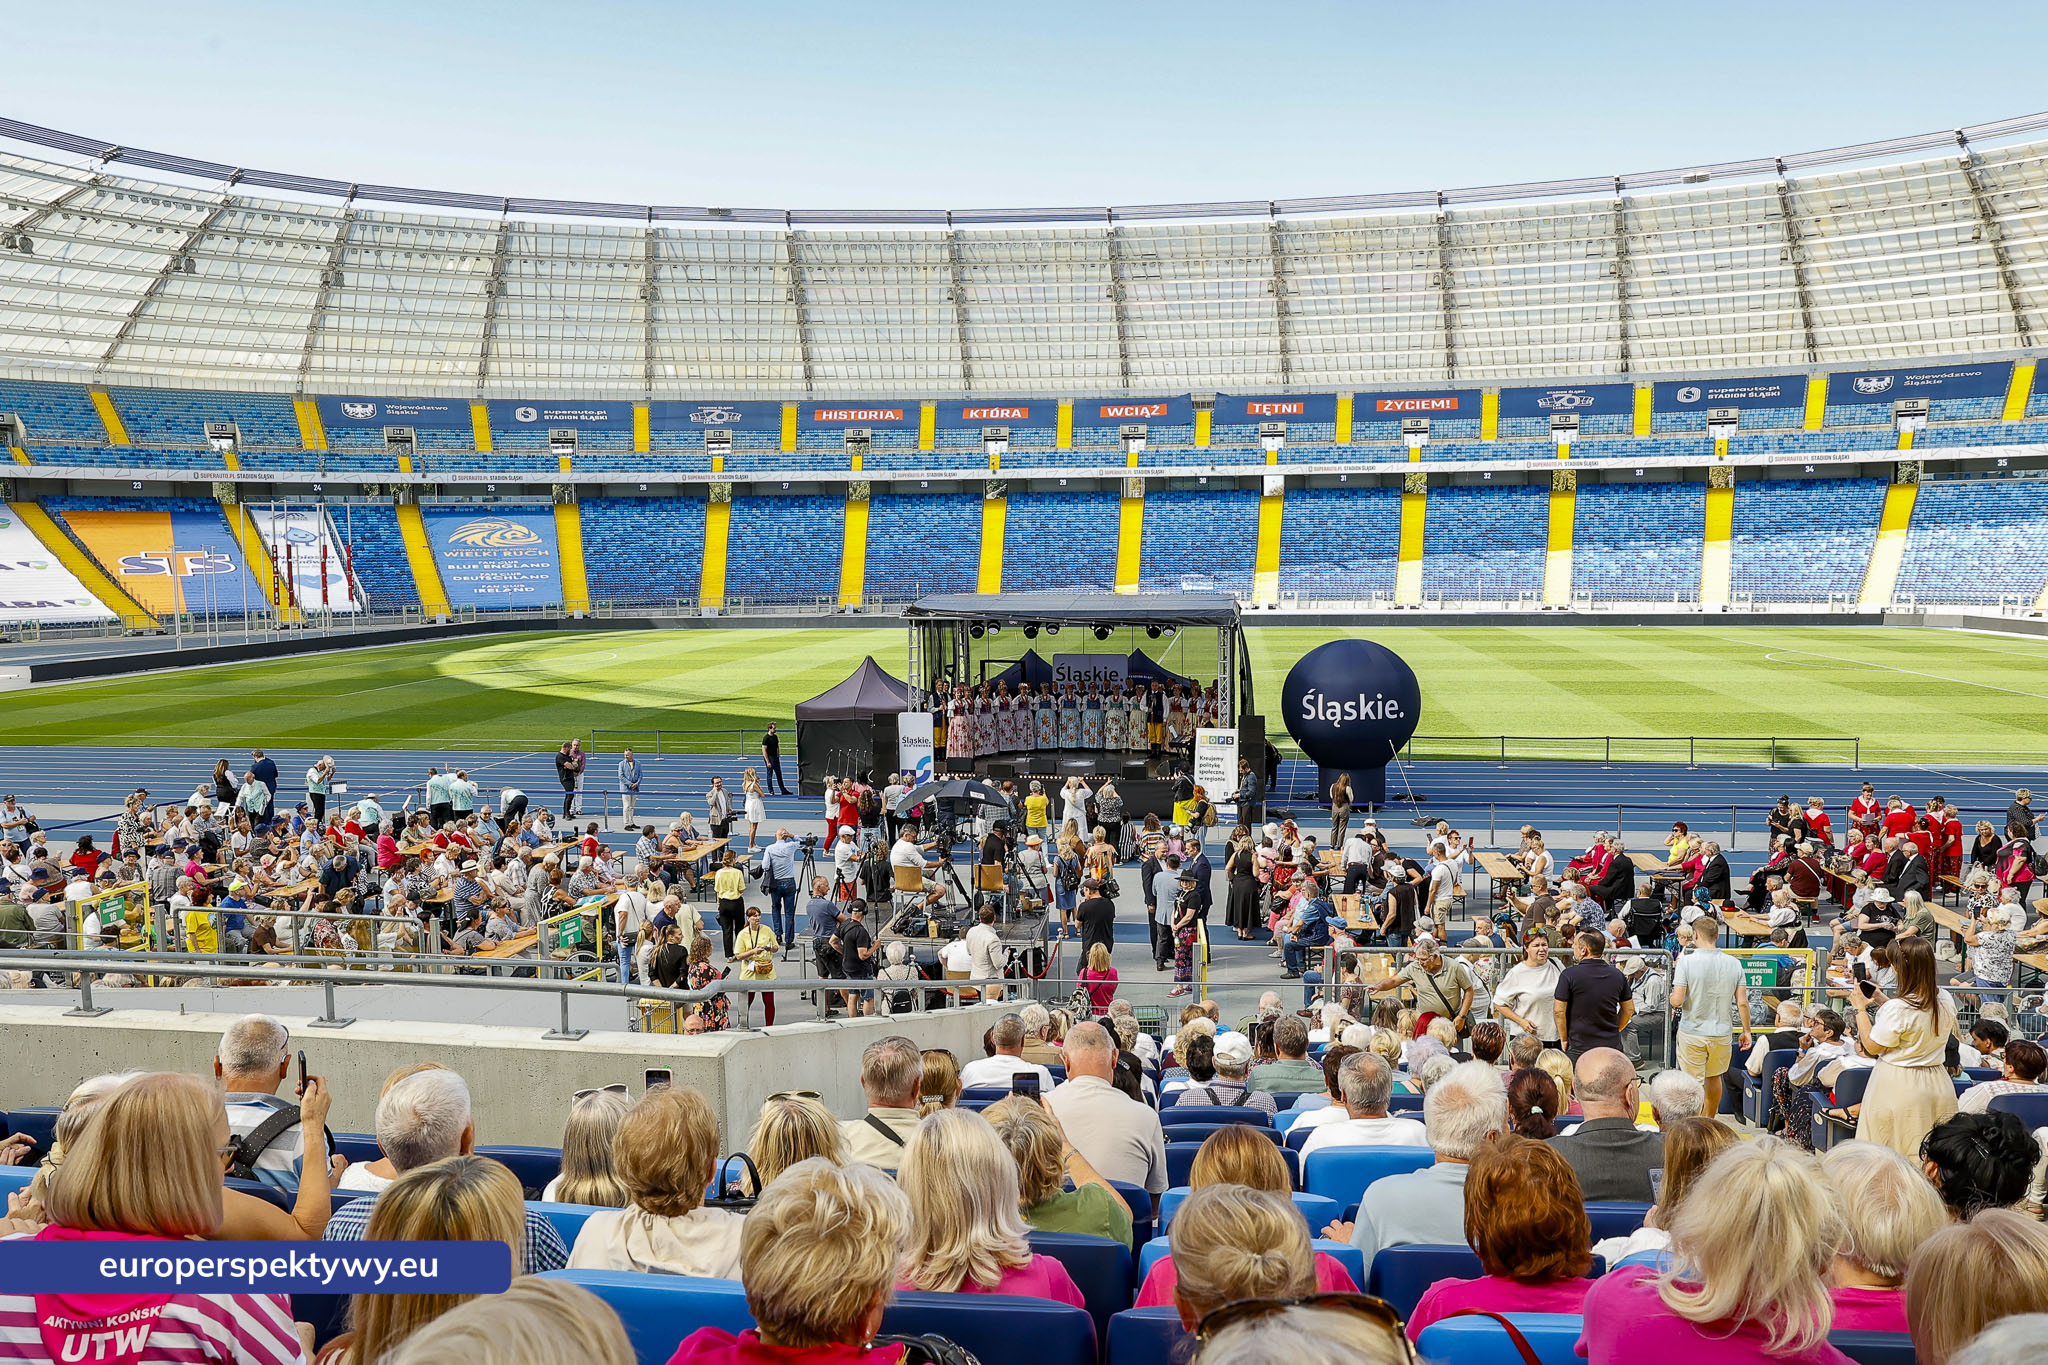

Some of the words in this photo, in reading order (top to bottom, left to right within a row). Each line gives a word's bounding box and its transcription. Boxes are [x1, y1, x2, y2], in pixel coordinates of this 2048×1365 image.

[1905, 371, 1982, 380] Województwo
[1708, 384, 1780, 394] superauto.pl
[1708, 390, 1746, 399] STADION
[1748, 390, 1780, 398] ŚLĄSKI
[1252, 404, 1297, 416] TĘTNI
[1384, 400, 1450, 410] ŻYCIEM!
[822, 411, 899, 420] HISTORIA,
[970, 407, 1022, 418] KTÓRA
[1107, 404, 1160, 418] WCIĄŻ
[118, 550, 237, 576] STS
[1302, 688, 1404, 728] Śląskie.
[902, 735, 932, 745] Śląskie.
[109, 912, 117, 921] 16
[568, 934, 574, 945] 15
[1751, 975, 1762, 986] 13
[43, 1315, 104, 1330] AKTYWNI
[60, 1324, 150, 1362] UTW
